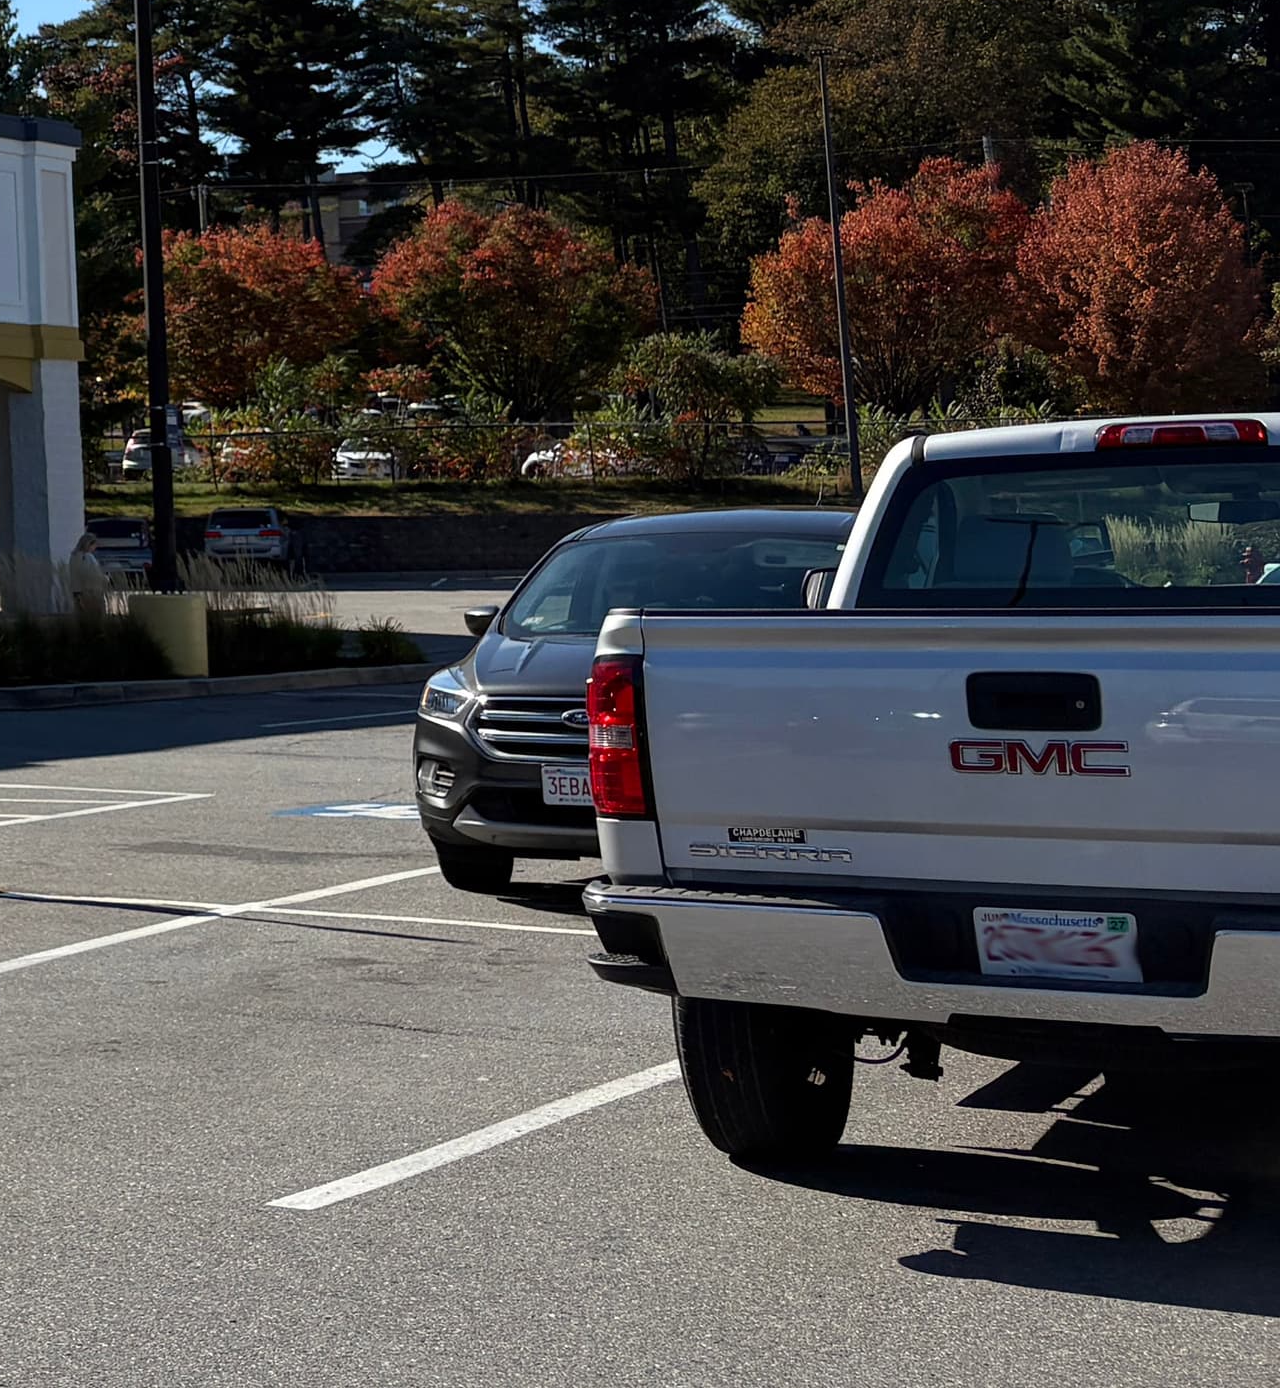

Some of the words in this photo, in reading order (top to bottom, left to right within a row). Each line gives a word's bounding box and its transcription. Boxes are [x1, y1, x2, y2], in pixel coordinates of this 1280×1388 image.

[949, 738, 1131, 778] GMC
[732, 827, 801, 838] CHAPDELAINE
[689, 842, 853, 863] SIERRA
[1010, 913, 1099, 928] Massachusetts
[1109, 920, 1126, 931] 27
